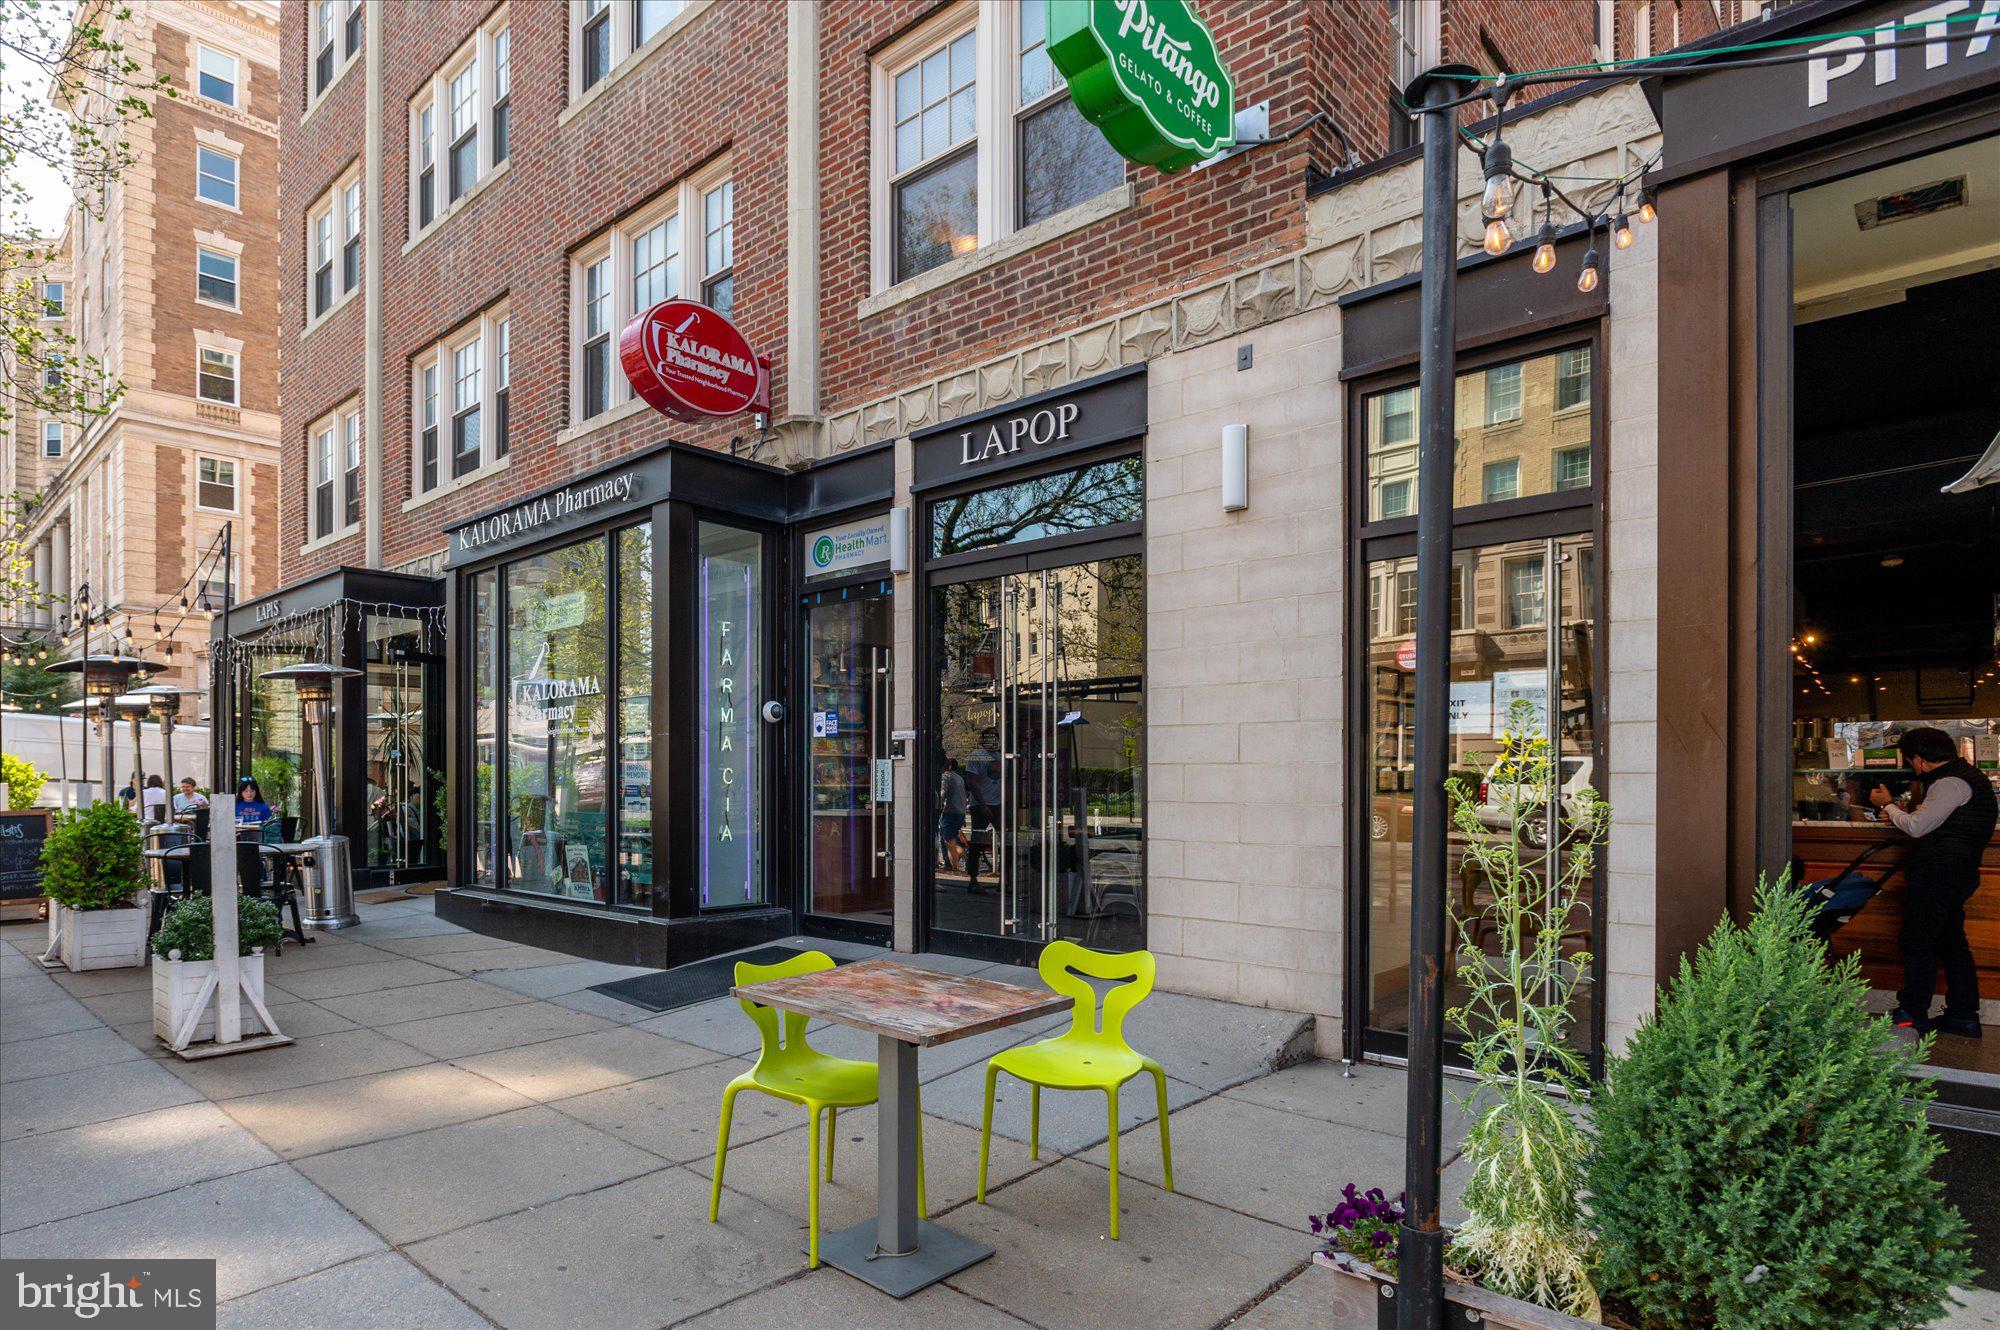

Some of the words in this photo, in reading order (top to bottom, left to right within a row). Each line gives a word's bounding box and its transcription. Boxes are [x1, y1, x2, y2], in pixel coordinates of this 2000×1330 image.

[1119, 52, 1162, 95] GELATO
[1166, 90, 1173, 105] &
[1176, 99, 1213, 137] COFFEE
[666, 331, 755, 377] KALORAMA
[666, 348, 731, 384] Pharmacy
[665, 366, 677, 376] Your
[677, 370, 695, 381] Trusted
[695, 376, 727, 392] Neighborhood
[959, 402, 1079, 466] LAPOP
[458, 498, 551, 551] KALORAMA
[555, 472, 635, 518] Pharmacy
[866, 526, 885, 535] Owned
[835, 537, 865, 554] Health
[866, 535, 887, 547] Mart
[835, 550, 865, 560] PHARMACY
[256, 599, 280, 621] LAPIS
[522, 675, 601, 703] KALORAMA
[524, 705, 576, 722] Pharmacy
[1450, 699, 1466, 707] XIT
[1450, 711, 1469, 719] NLY
[721, 621, 733, 842] FARMACIA
